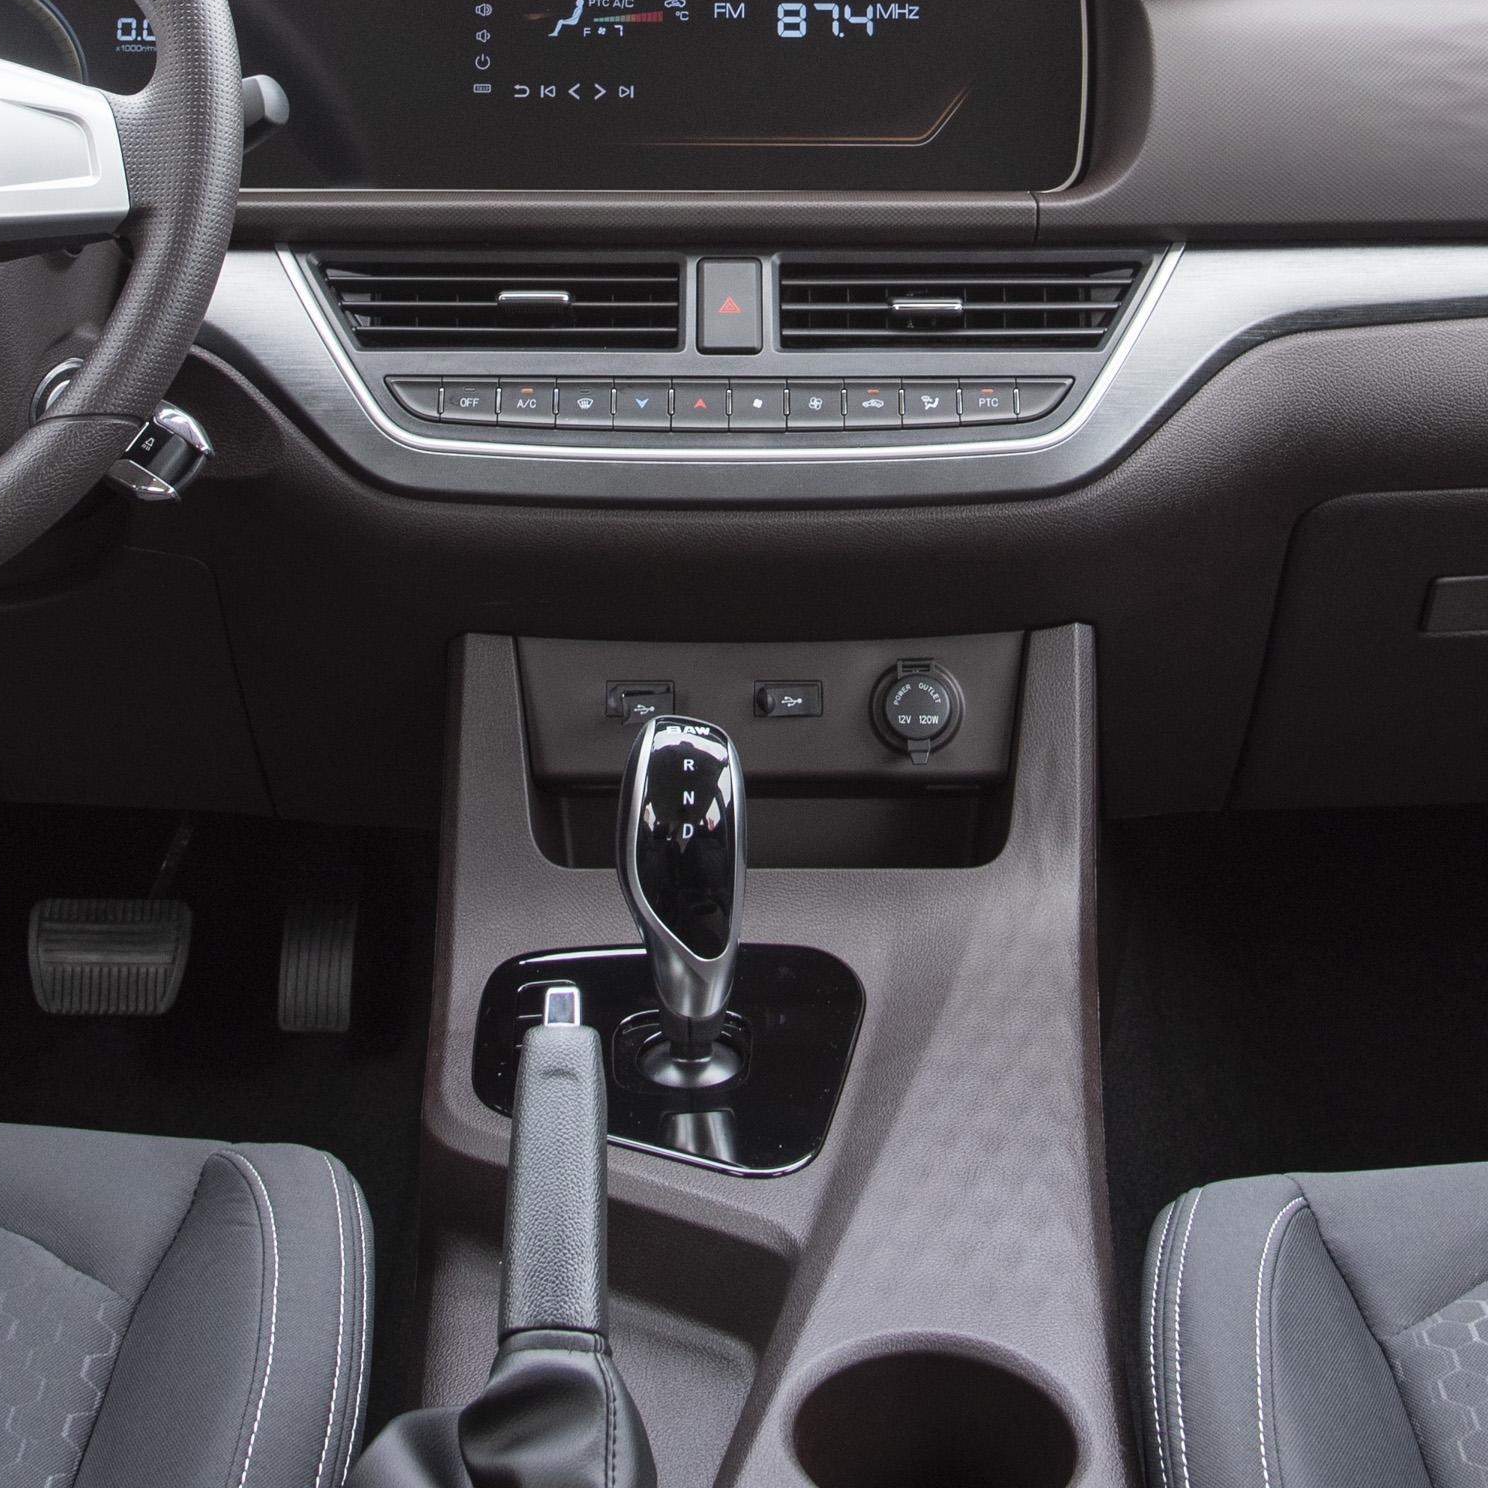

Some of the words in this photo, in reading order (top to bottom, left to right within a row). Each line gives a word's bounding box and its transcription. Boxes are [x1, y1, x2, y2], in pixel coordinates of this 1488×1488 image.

[714, 3, 745, 19] FM
[777, 3, 874, 38] 87.4
[876, 3, 920, 19] MHz
[459, 397, 480, 408] OFF
[516, 398, 537, 409] A/C
[978, 397, 999, 407] PTC
[893, 683, 912, 706] POWER
[918, 682, 942, 704] OUTLET
[898, 715, 912, 724] 12V
[919, 715, 939, 724] 120W
[666, 725, 710, 736] BAW
[683, 758, 695, 771] R
[683, 790, 695, 805] N
[682, 823, 694, 839] D
